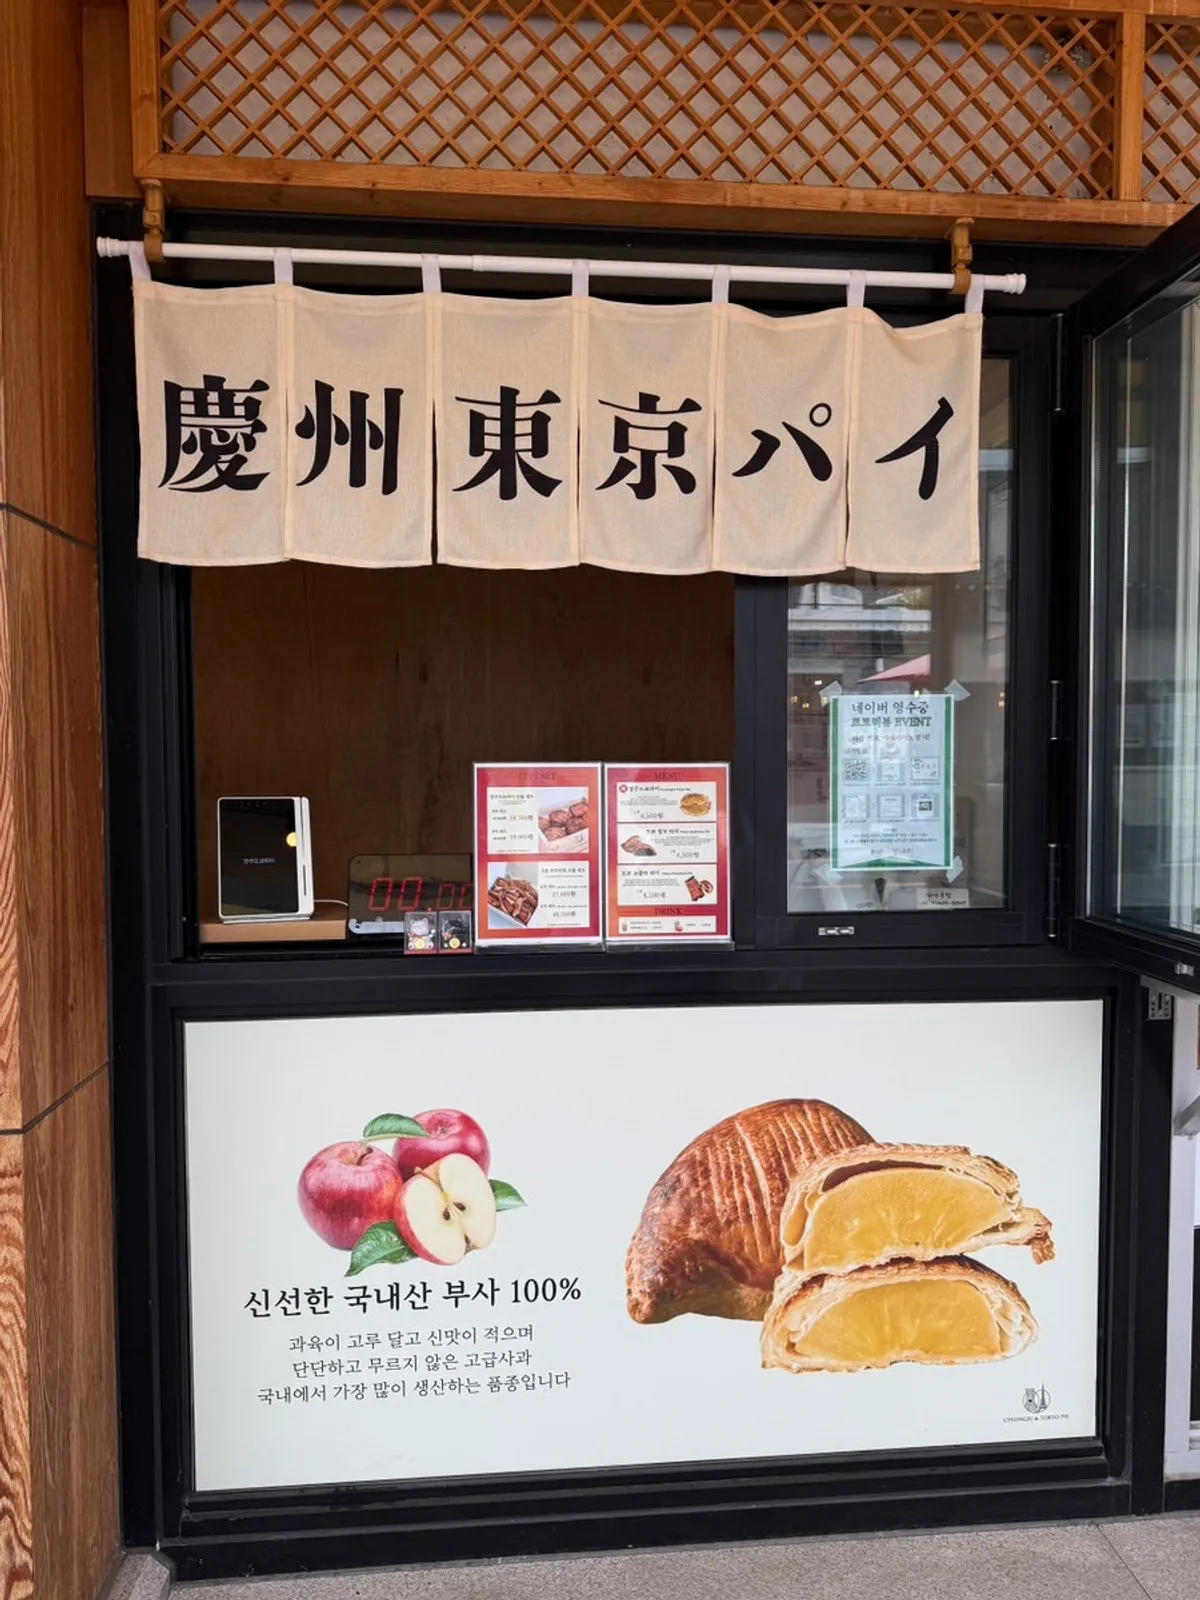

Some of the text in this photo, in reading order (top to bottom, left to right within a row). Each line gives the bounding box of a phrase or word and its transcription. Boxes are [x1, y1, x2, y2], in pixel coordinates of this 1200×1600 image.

[158, 375, 955, 501] 慶州東京パイ
[851, 701, 888, 715] 네이버
[894, 716, 932, 727] EVENT
[654, 771, 681, 780] MENU
[654, 907, 683, 916] DRINK
[243, 1276, 582, 1318] 신선한 국내산 부사 100%
[288, 1324, 534, 1353] 과육이 고루 달고 신맛이 적으며
[292, 1349, 533, 1379] 단단하고 무르지 않은 고급사과
[257, 1371, 572, 1405] 국내에서 가장 많이 생산하는 품종입니다
